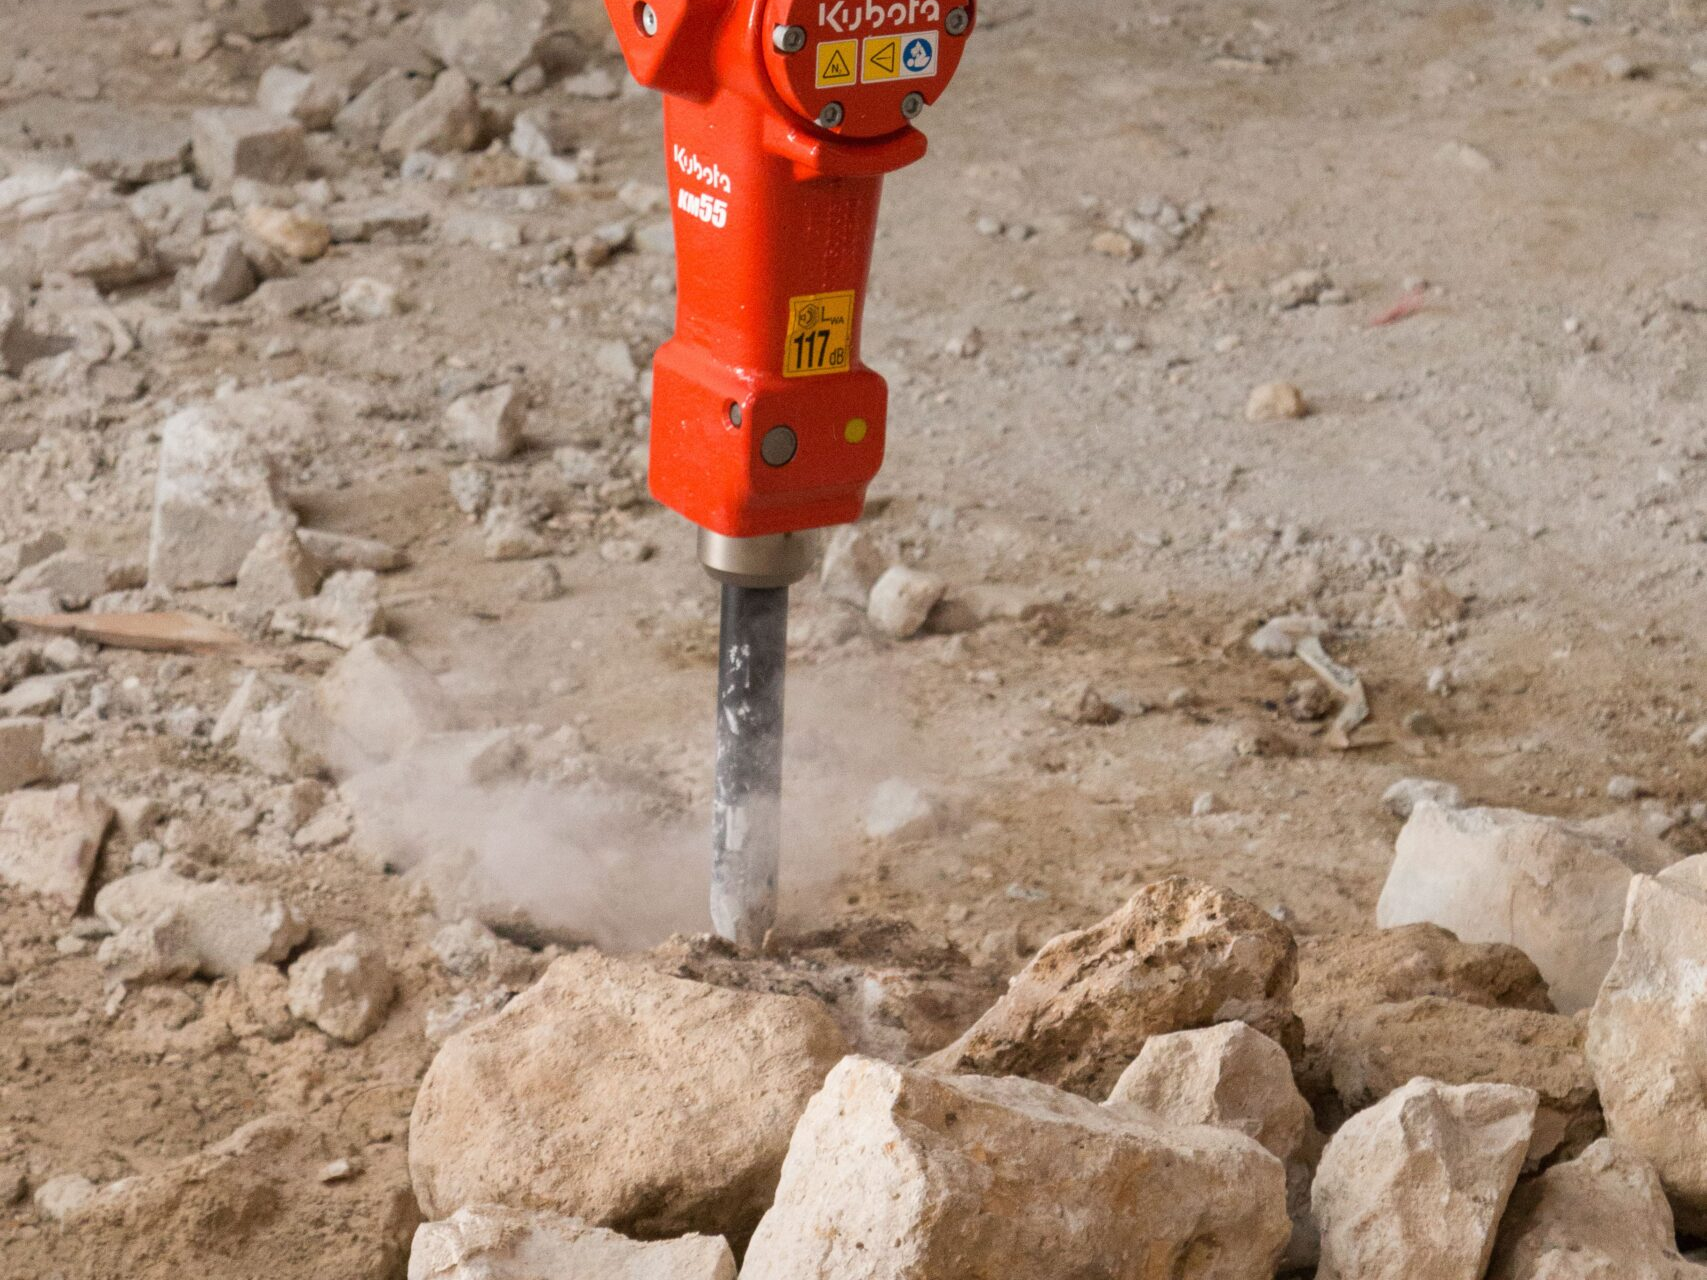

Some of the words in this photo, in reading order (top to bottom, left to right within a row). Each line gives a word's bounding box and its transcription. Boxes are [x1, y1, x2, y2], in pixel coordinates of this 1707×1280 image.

[673, 143, 731, 194] Kubota
[678, 188, 728, 229] KM55
[794, 329, 830, 369] 117
[829, 347, 844, 366] dB
